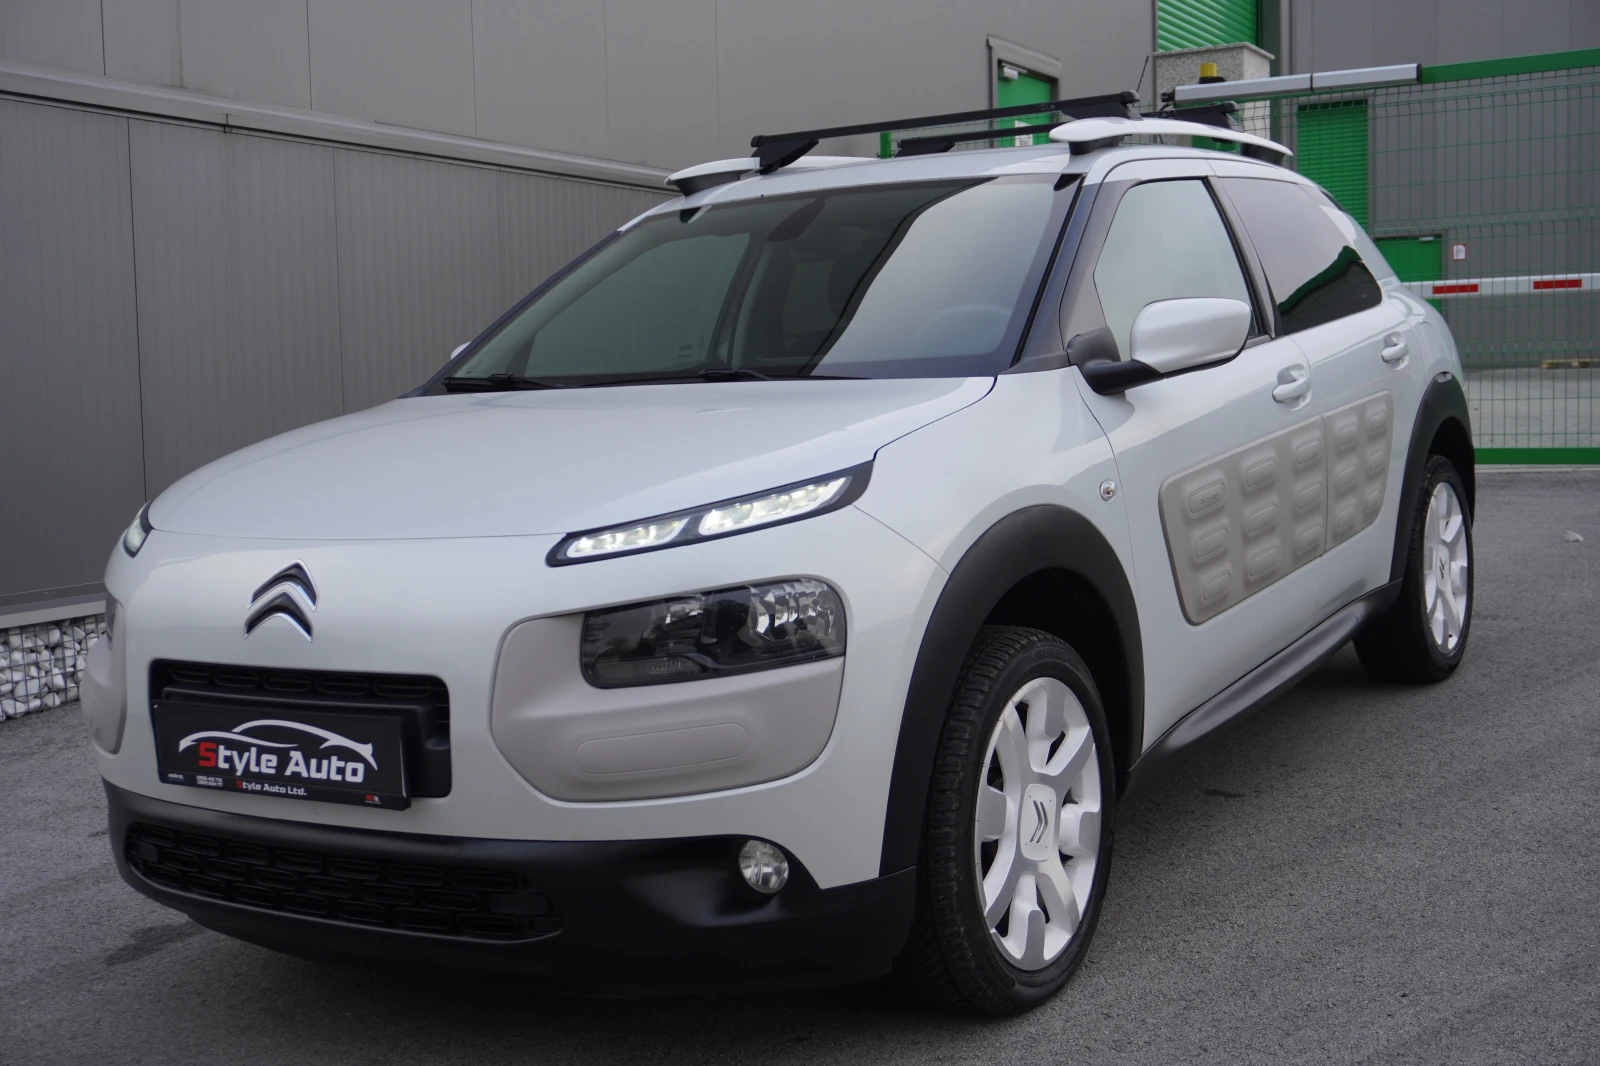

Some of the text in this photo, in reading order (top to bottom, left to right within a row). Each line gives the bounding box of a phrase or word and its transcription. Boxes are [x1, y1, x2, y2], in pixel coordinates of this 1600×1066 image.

[199, 742, 365, 783] Style Auto
[236, 780, 262, 792] Style
[263, 783, 286, 795] Auto
[287, 787, 307, 797] Ltd.
